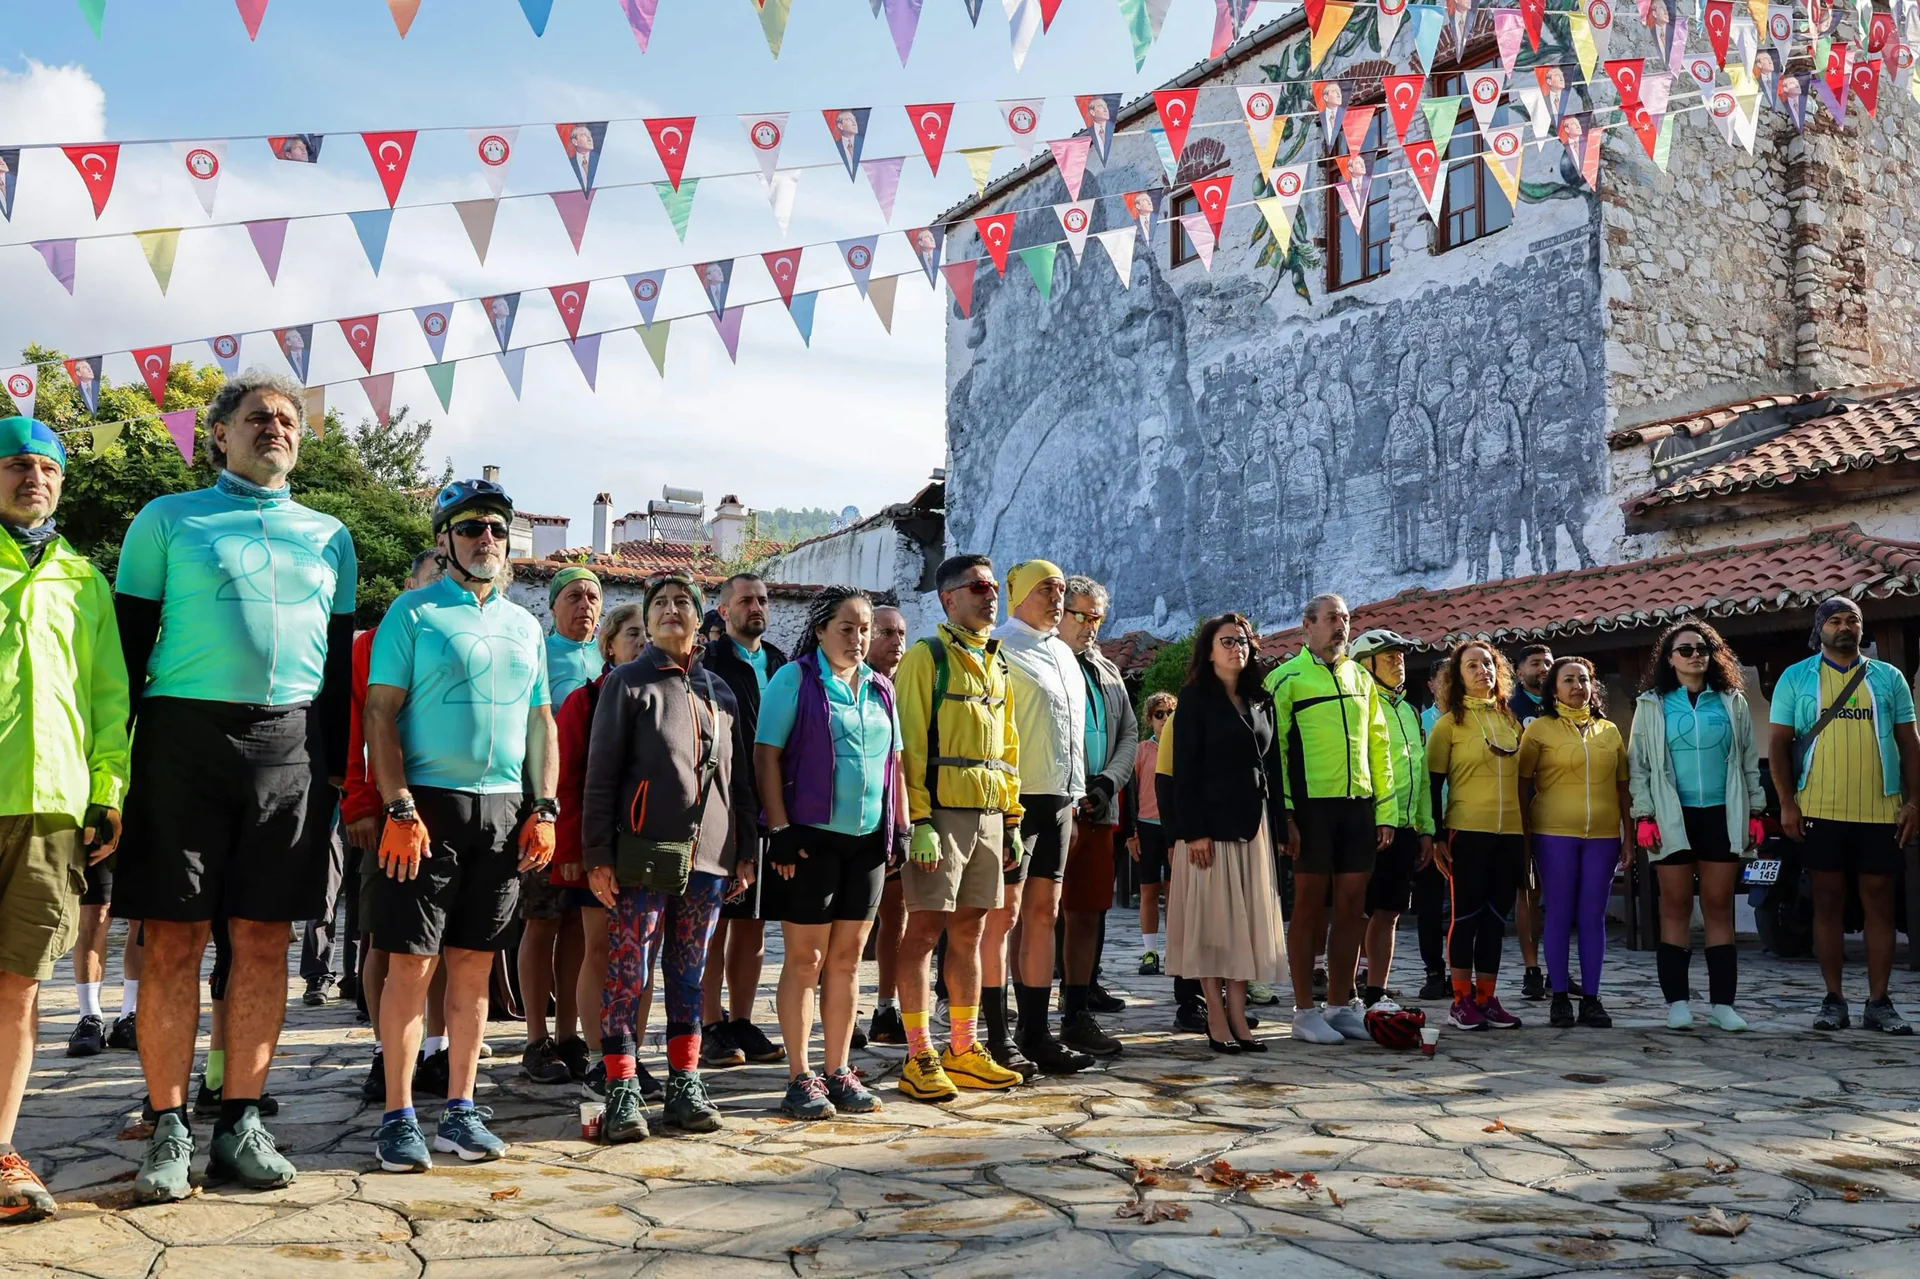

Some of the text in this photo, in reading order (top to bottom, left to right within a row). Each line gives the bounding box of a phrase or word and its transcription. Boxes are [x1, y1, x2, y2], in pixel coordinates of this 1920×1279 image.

[1747, 861, 1779, 871] 48 APZ
[1759, 871, 1776, 880] 145
